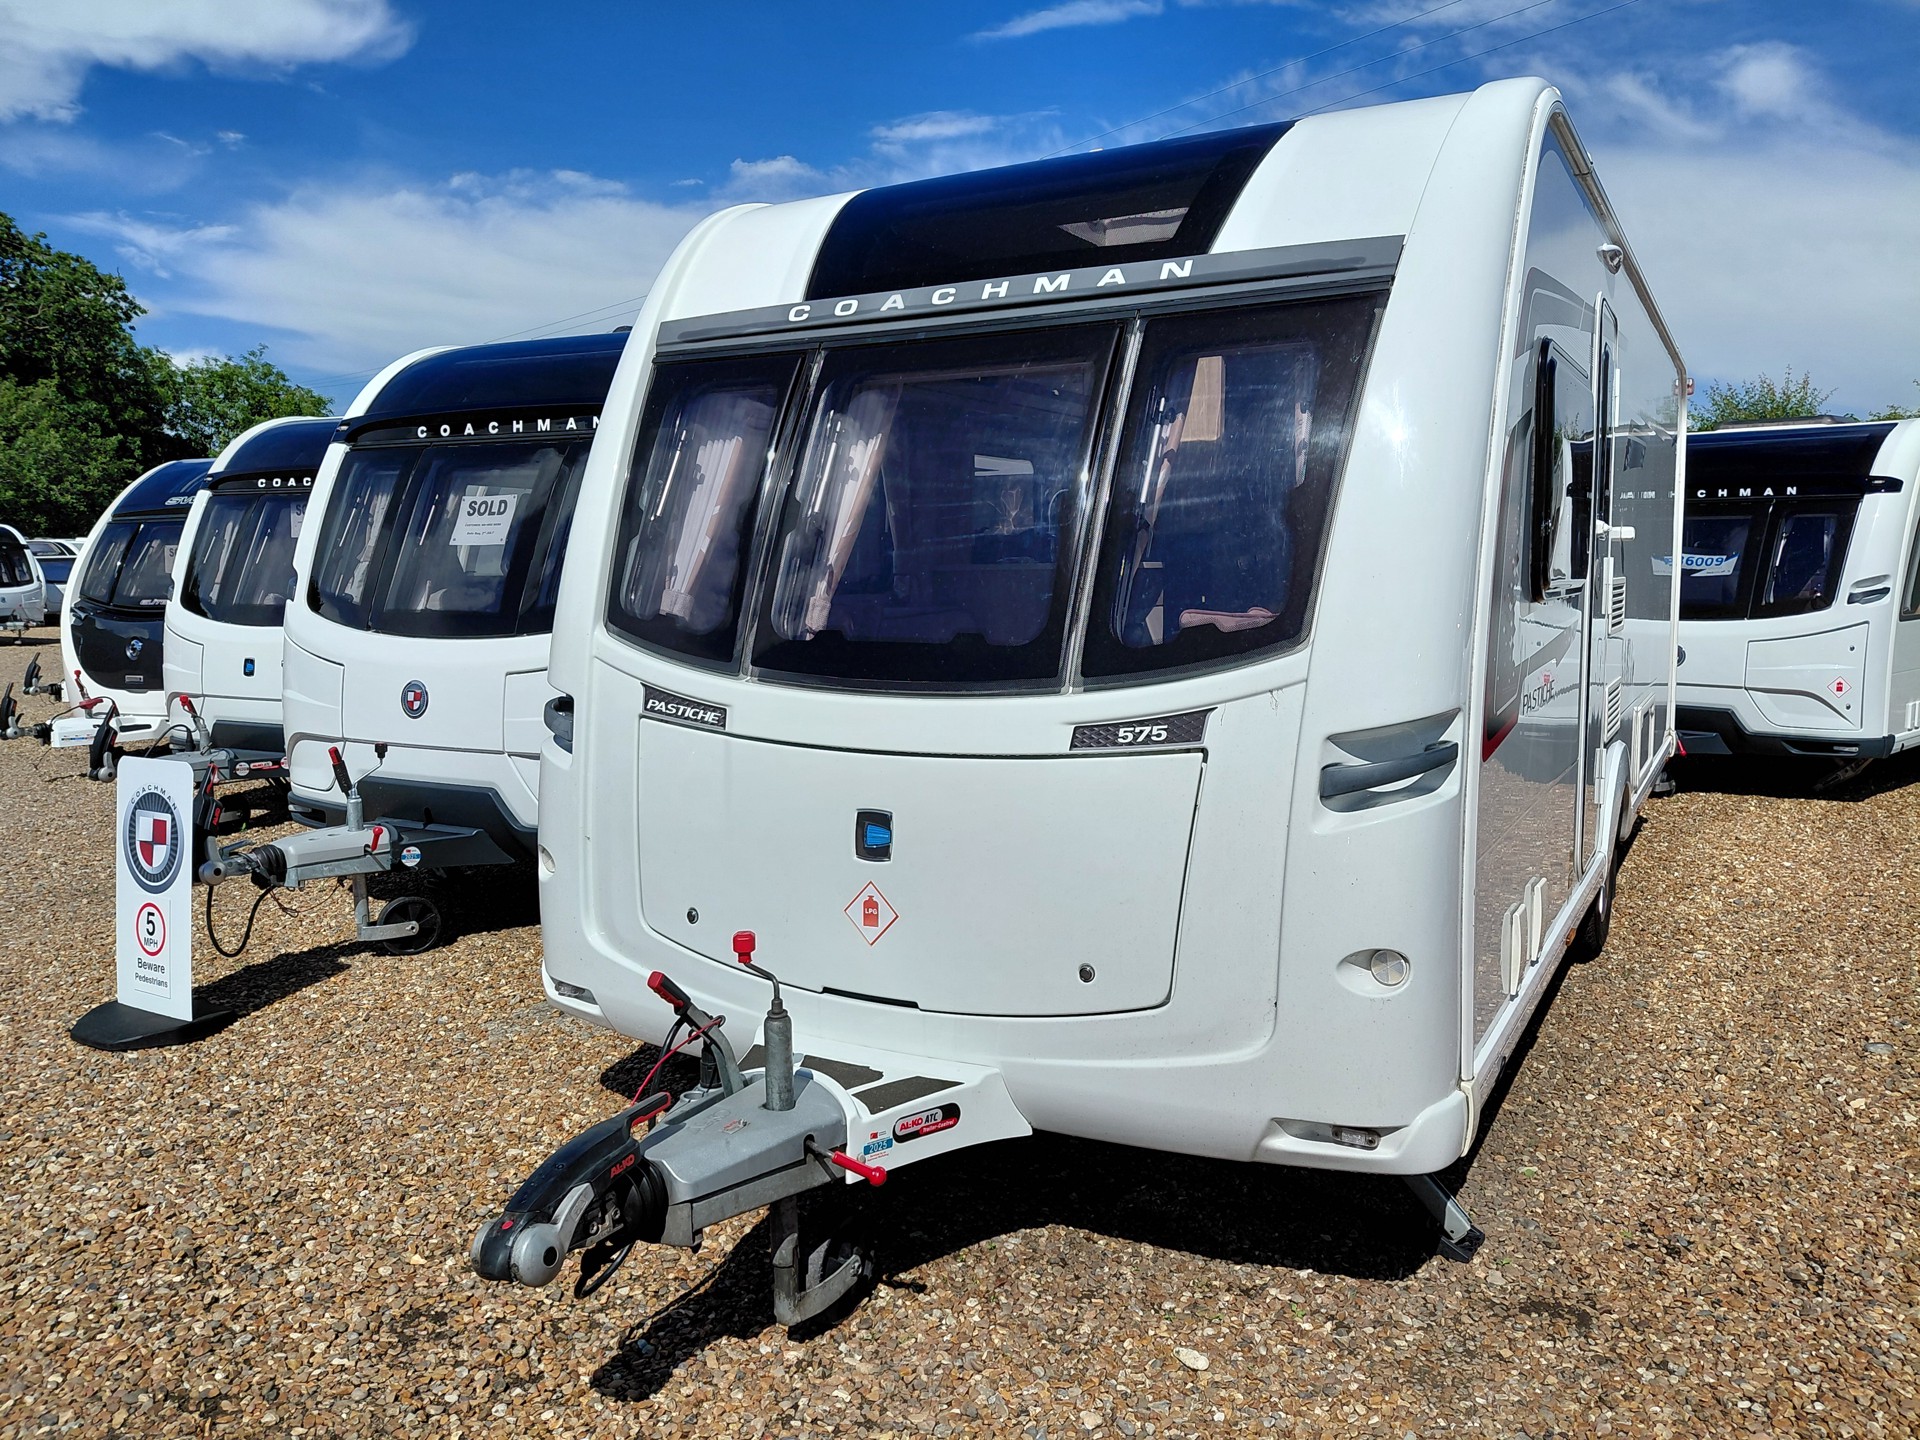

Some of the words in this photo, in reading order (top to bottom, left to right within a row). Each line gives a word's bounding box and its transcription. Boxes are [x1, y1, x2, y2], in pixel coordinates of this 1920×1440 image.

[787, 258, 1194, 323] COACHMAN
[257, 476, 312, 488] COAC
[466, 499, 508, 517] SOLD
[646, 699, 722, 724] PASTICHE
[1117, 724, 1169, 743] 575
[130, 784, 177, 811] COACHMAN
[864, 907, 878, 915] LPG
[146, 911, 156, 936] 5
[143, 937, 158, 949] MPH
[137, 957, 166, 975] Beware
[134, 972, 169, 989] Pedestrians
[899, 1117, 923, 1132] AL-KO
[924, 1111, 939, 1125] ATC
[869, 1141, 889, 1154] 2025
[610, 1153, 635, 1179] AL-KO
